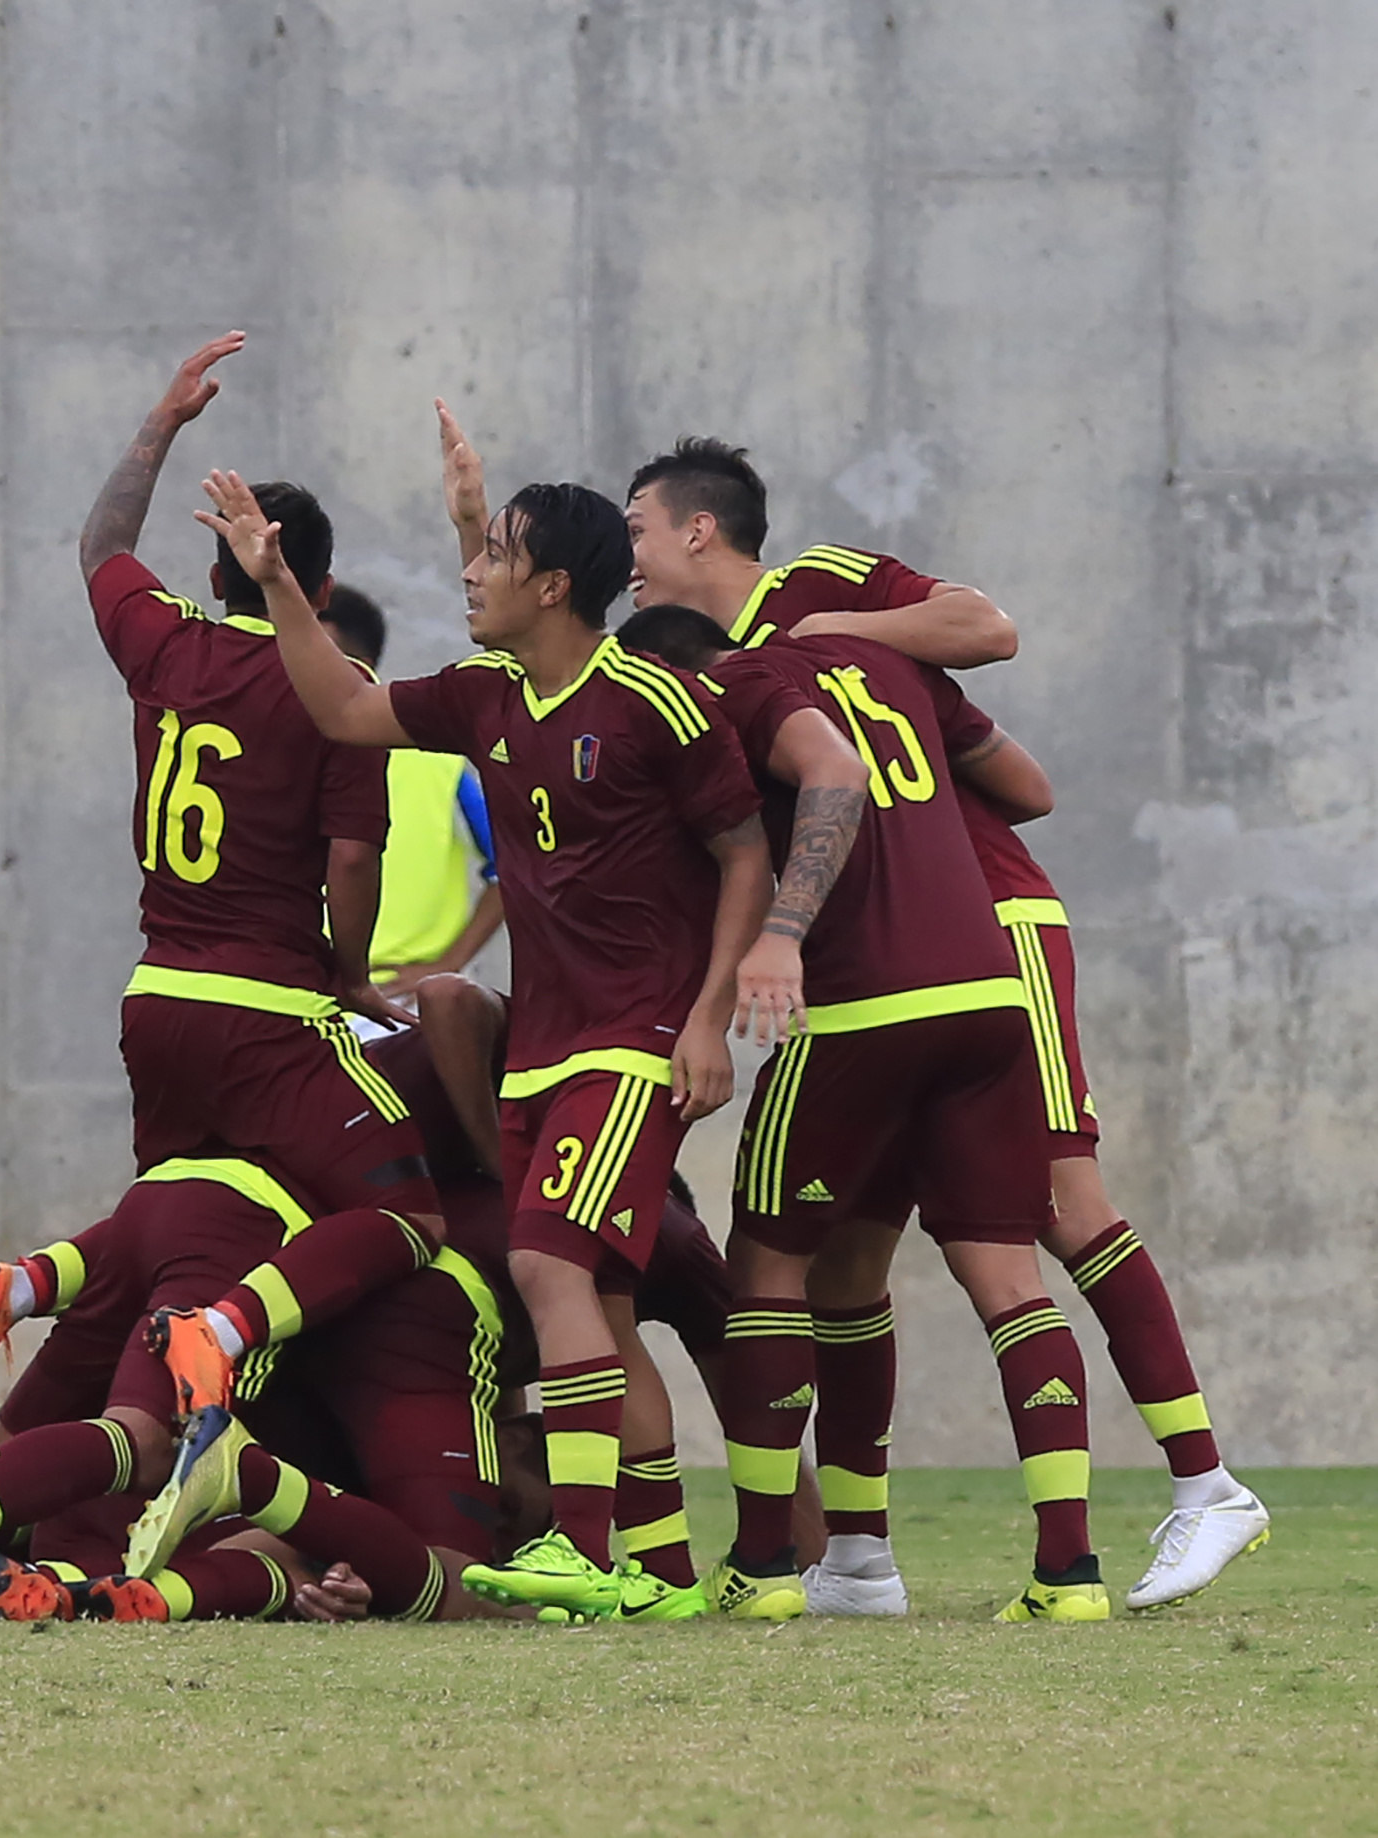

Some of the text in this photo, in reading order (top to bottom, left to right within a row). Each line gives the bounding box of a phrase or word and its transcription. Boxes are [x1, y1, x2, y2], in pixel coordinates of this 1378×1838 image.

[816, 664, 937, 809] 15
[141, 708, 244, 884] 16
[531, 787, 556, 852] 3
[541, 1136, 583, 1200] 3
